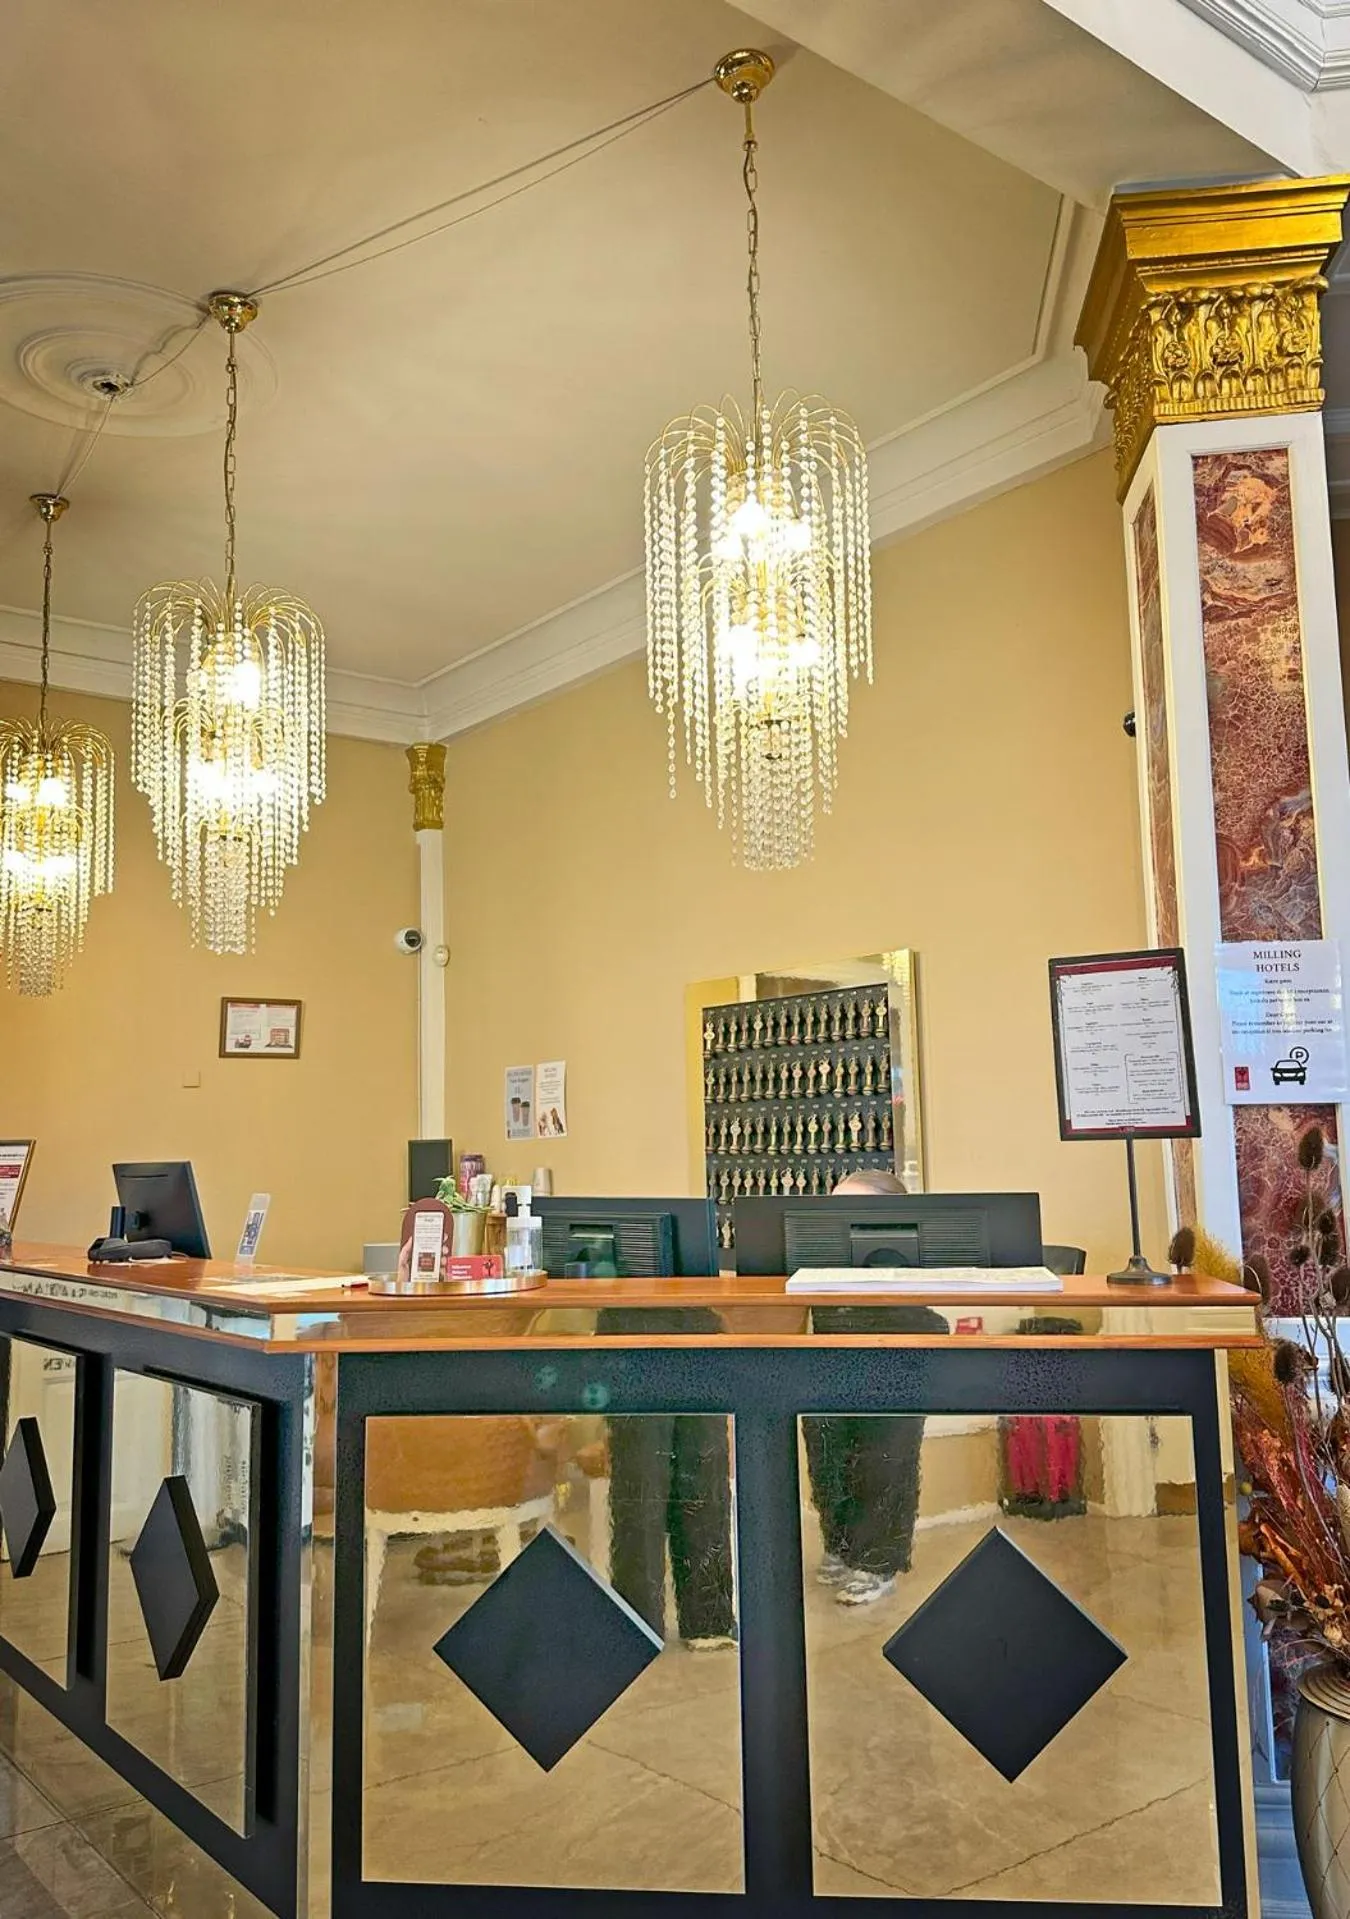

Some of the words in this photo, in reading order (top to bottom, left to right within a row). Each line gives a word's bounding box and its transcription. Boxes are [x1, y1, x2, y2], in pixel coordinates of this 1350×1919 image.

[1253, 950, 1301, 959] MILLING
[1256, 962, 1300, 972] HOTELS
[1296, 1051, 1304, 1059] P
